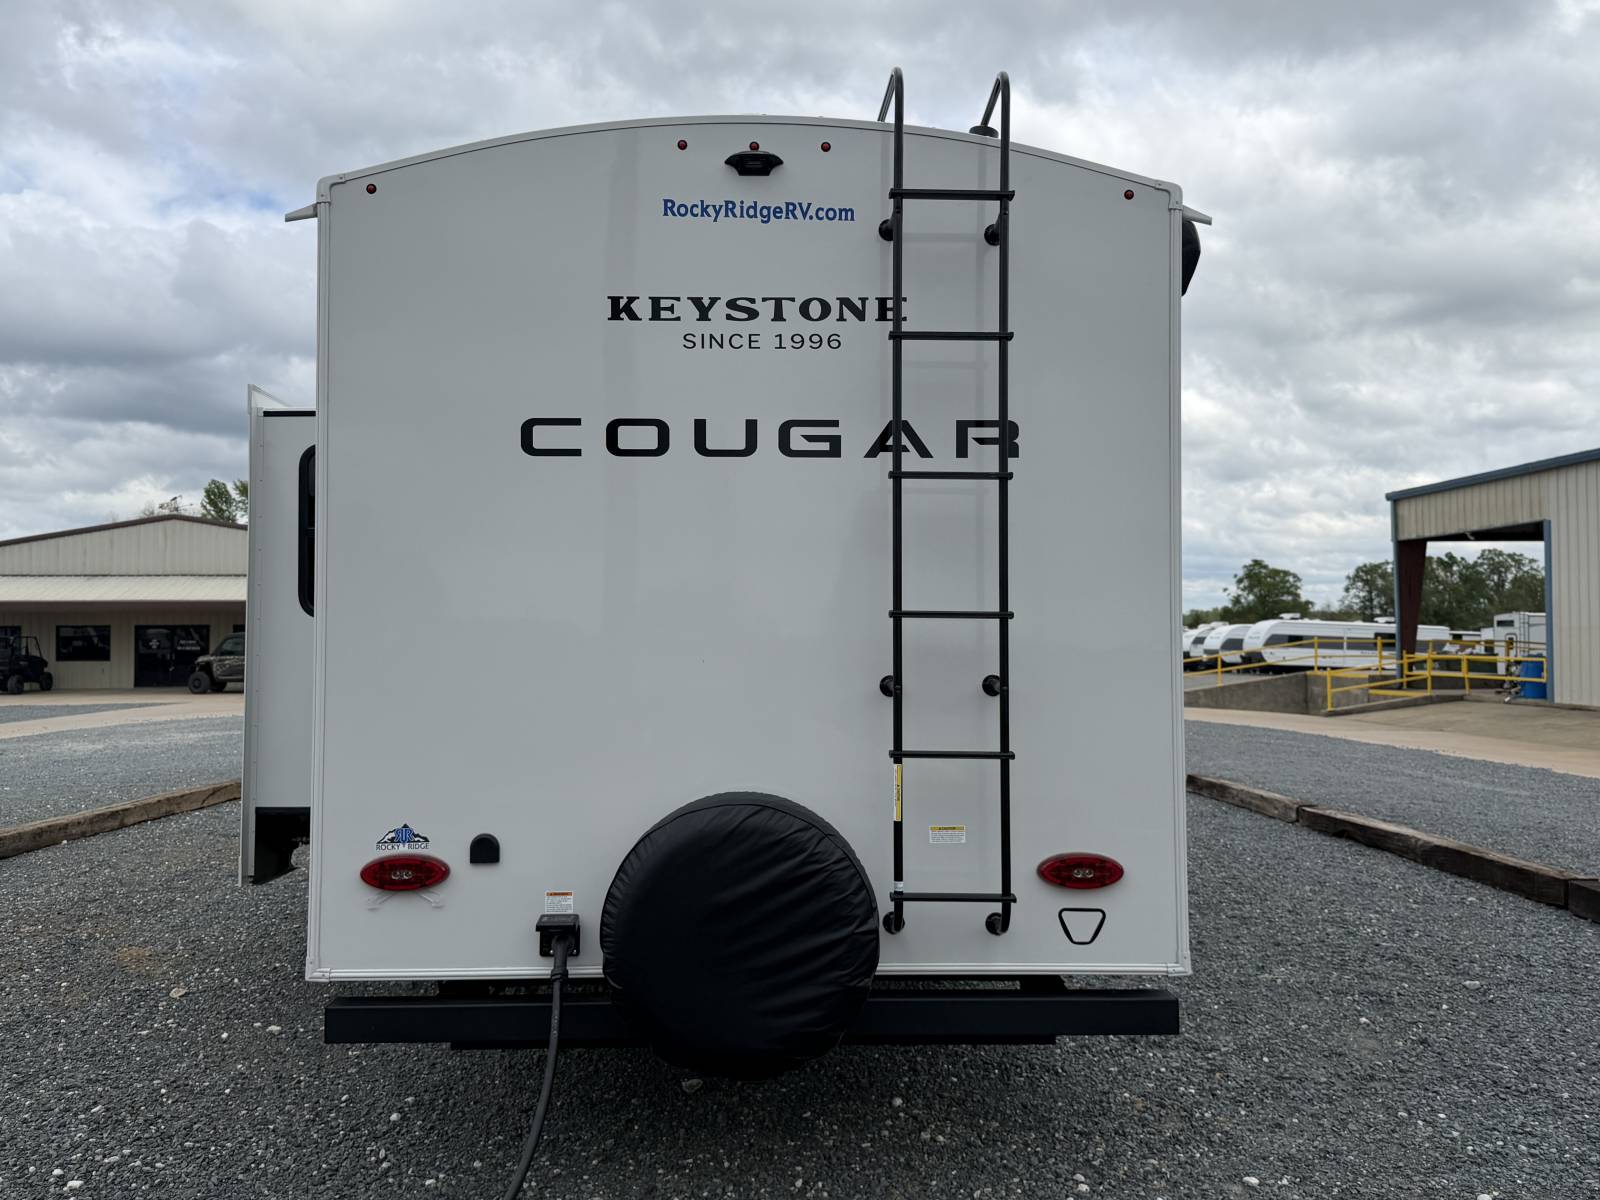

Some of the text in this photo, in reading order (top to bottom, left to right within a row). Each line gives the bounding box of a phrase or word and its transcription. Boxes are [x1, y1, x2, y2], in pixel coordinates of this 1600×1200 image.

[662, 198, 856, 224] RockyRidgeRV.com
[607, 296, 908, 323] KEYSTONE
[682, 332, 843, 350] SINCE 1996
[520, 417, 1021, 459] COUGAR
[375, 842, 430, 851] ROCKY RIDGE
